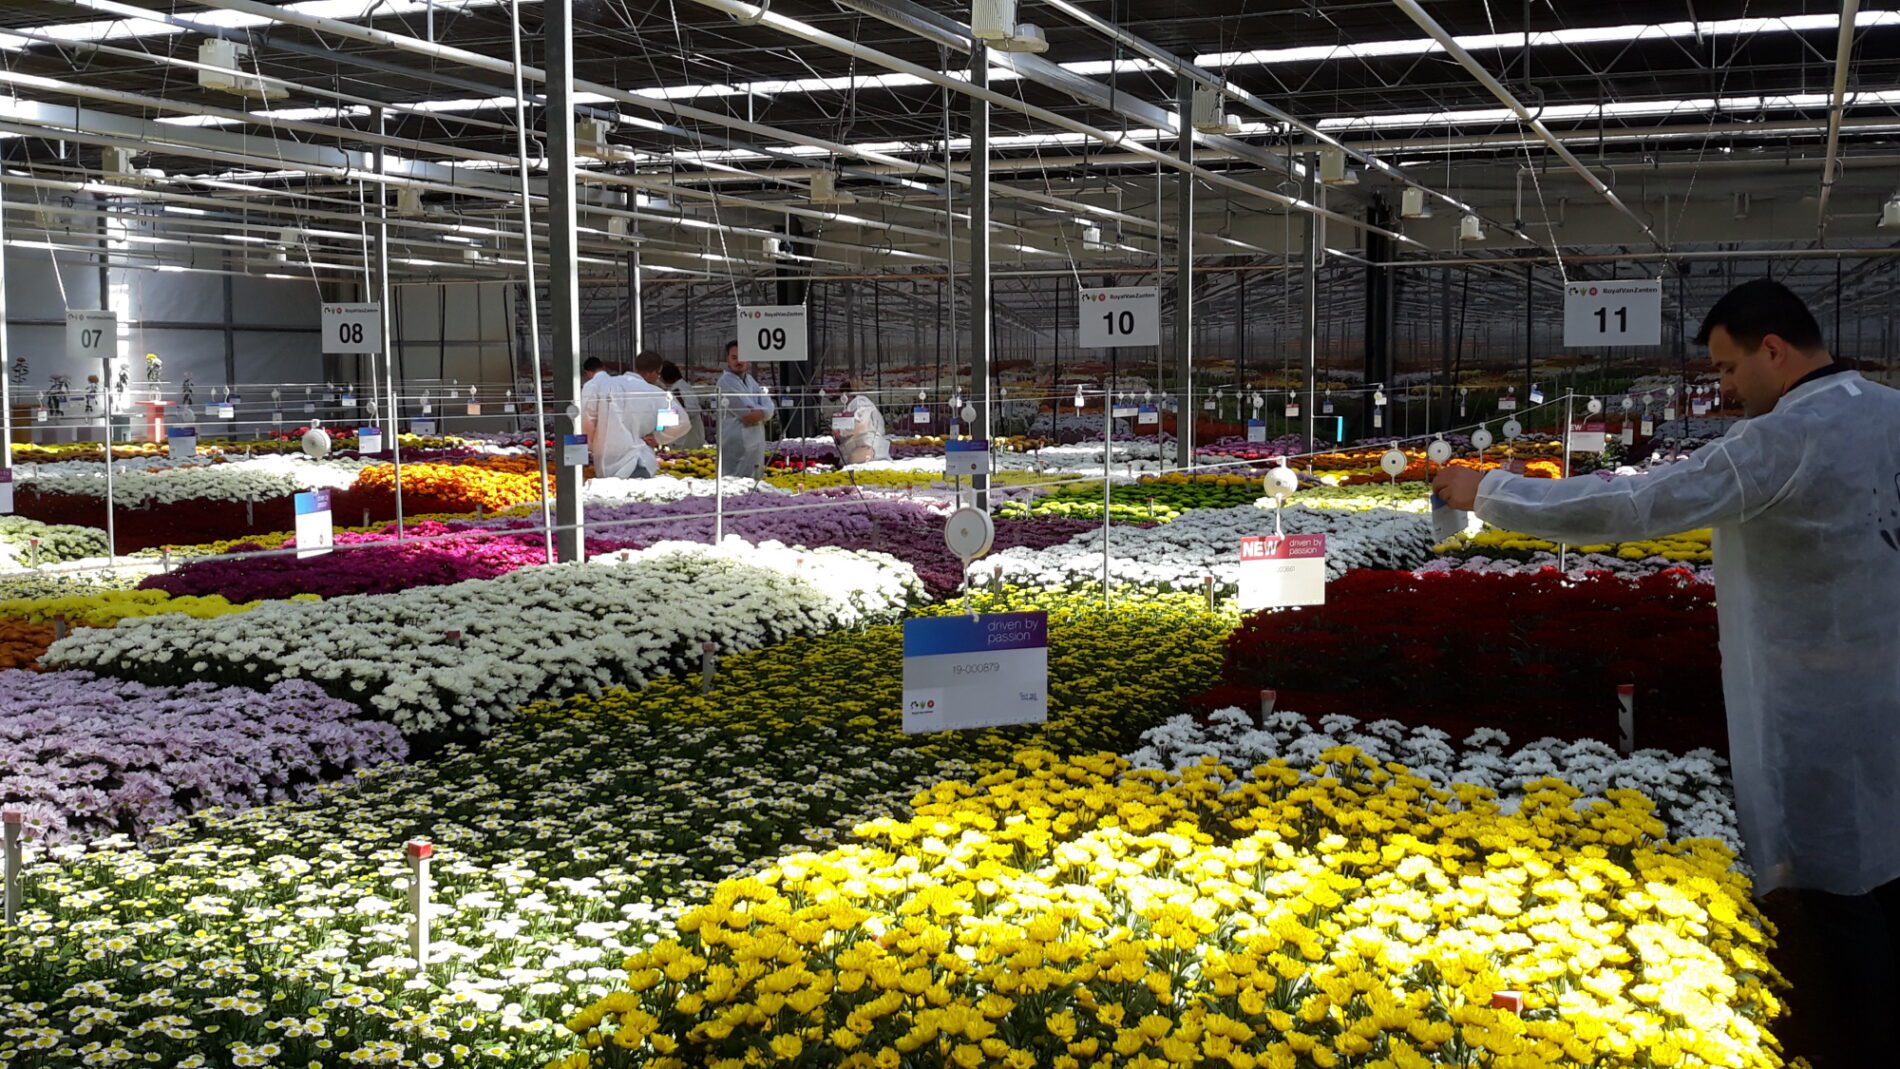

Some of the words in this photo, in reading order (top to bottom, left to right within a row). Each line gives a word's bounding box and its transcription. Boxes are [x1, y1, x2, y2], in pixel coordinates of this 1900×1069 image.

[1602, 286, 1658, 295] RoyalVanZanten
[1103, 311, 1134, 335] 10
[1594, 307, 1626, 333] 11
[81, 329, 102, 348] 07
[339, 323, 363, 344] 08
[758, 328, 786, 350] 09
[1243, 540, 1279, 558] NEW
[1289, 539, 1312, 547] driven
[1313, 539, 1322, 547] by
[1289, 547, 1318, 557] passion
[987, 620, 1022, 631] driven
[1025, 618, 1039, 630] by
[987, 631, 1031, 645] passion
